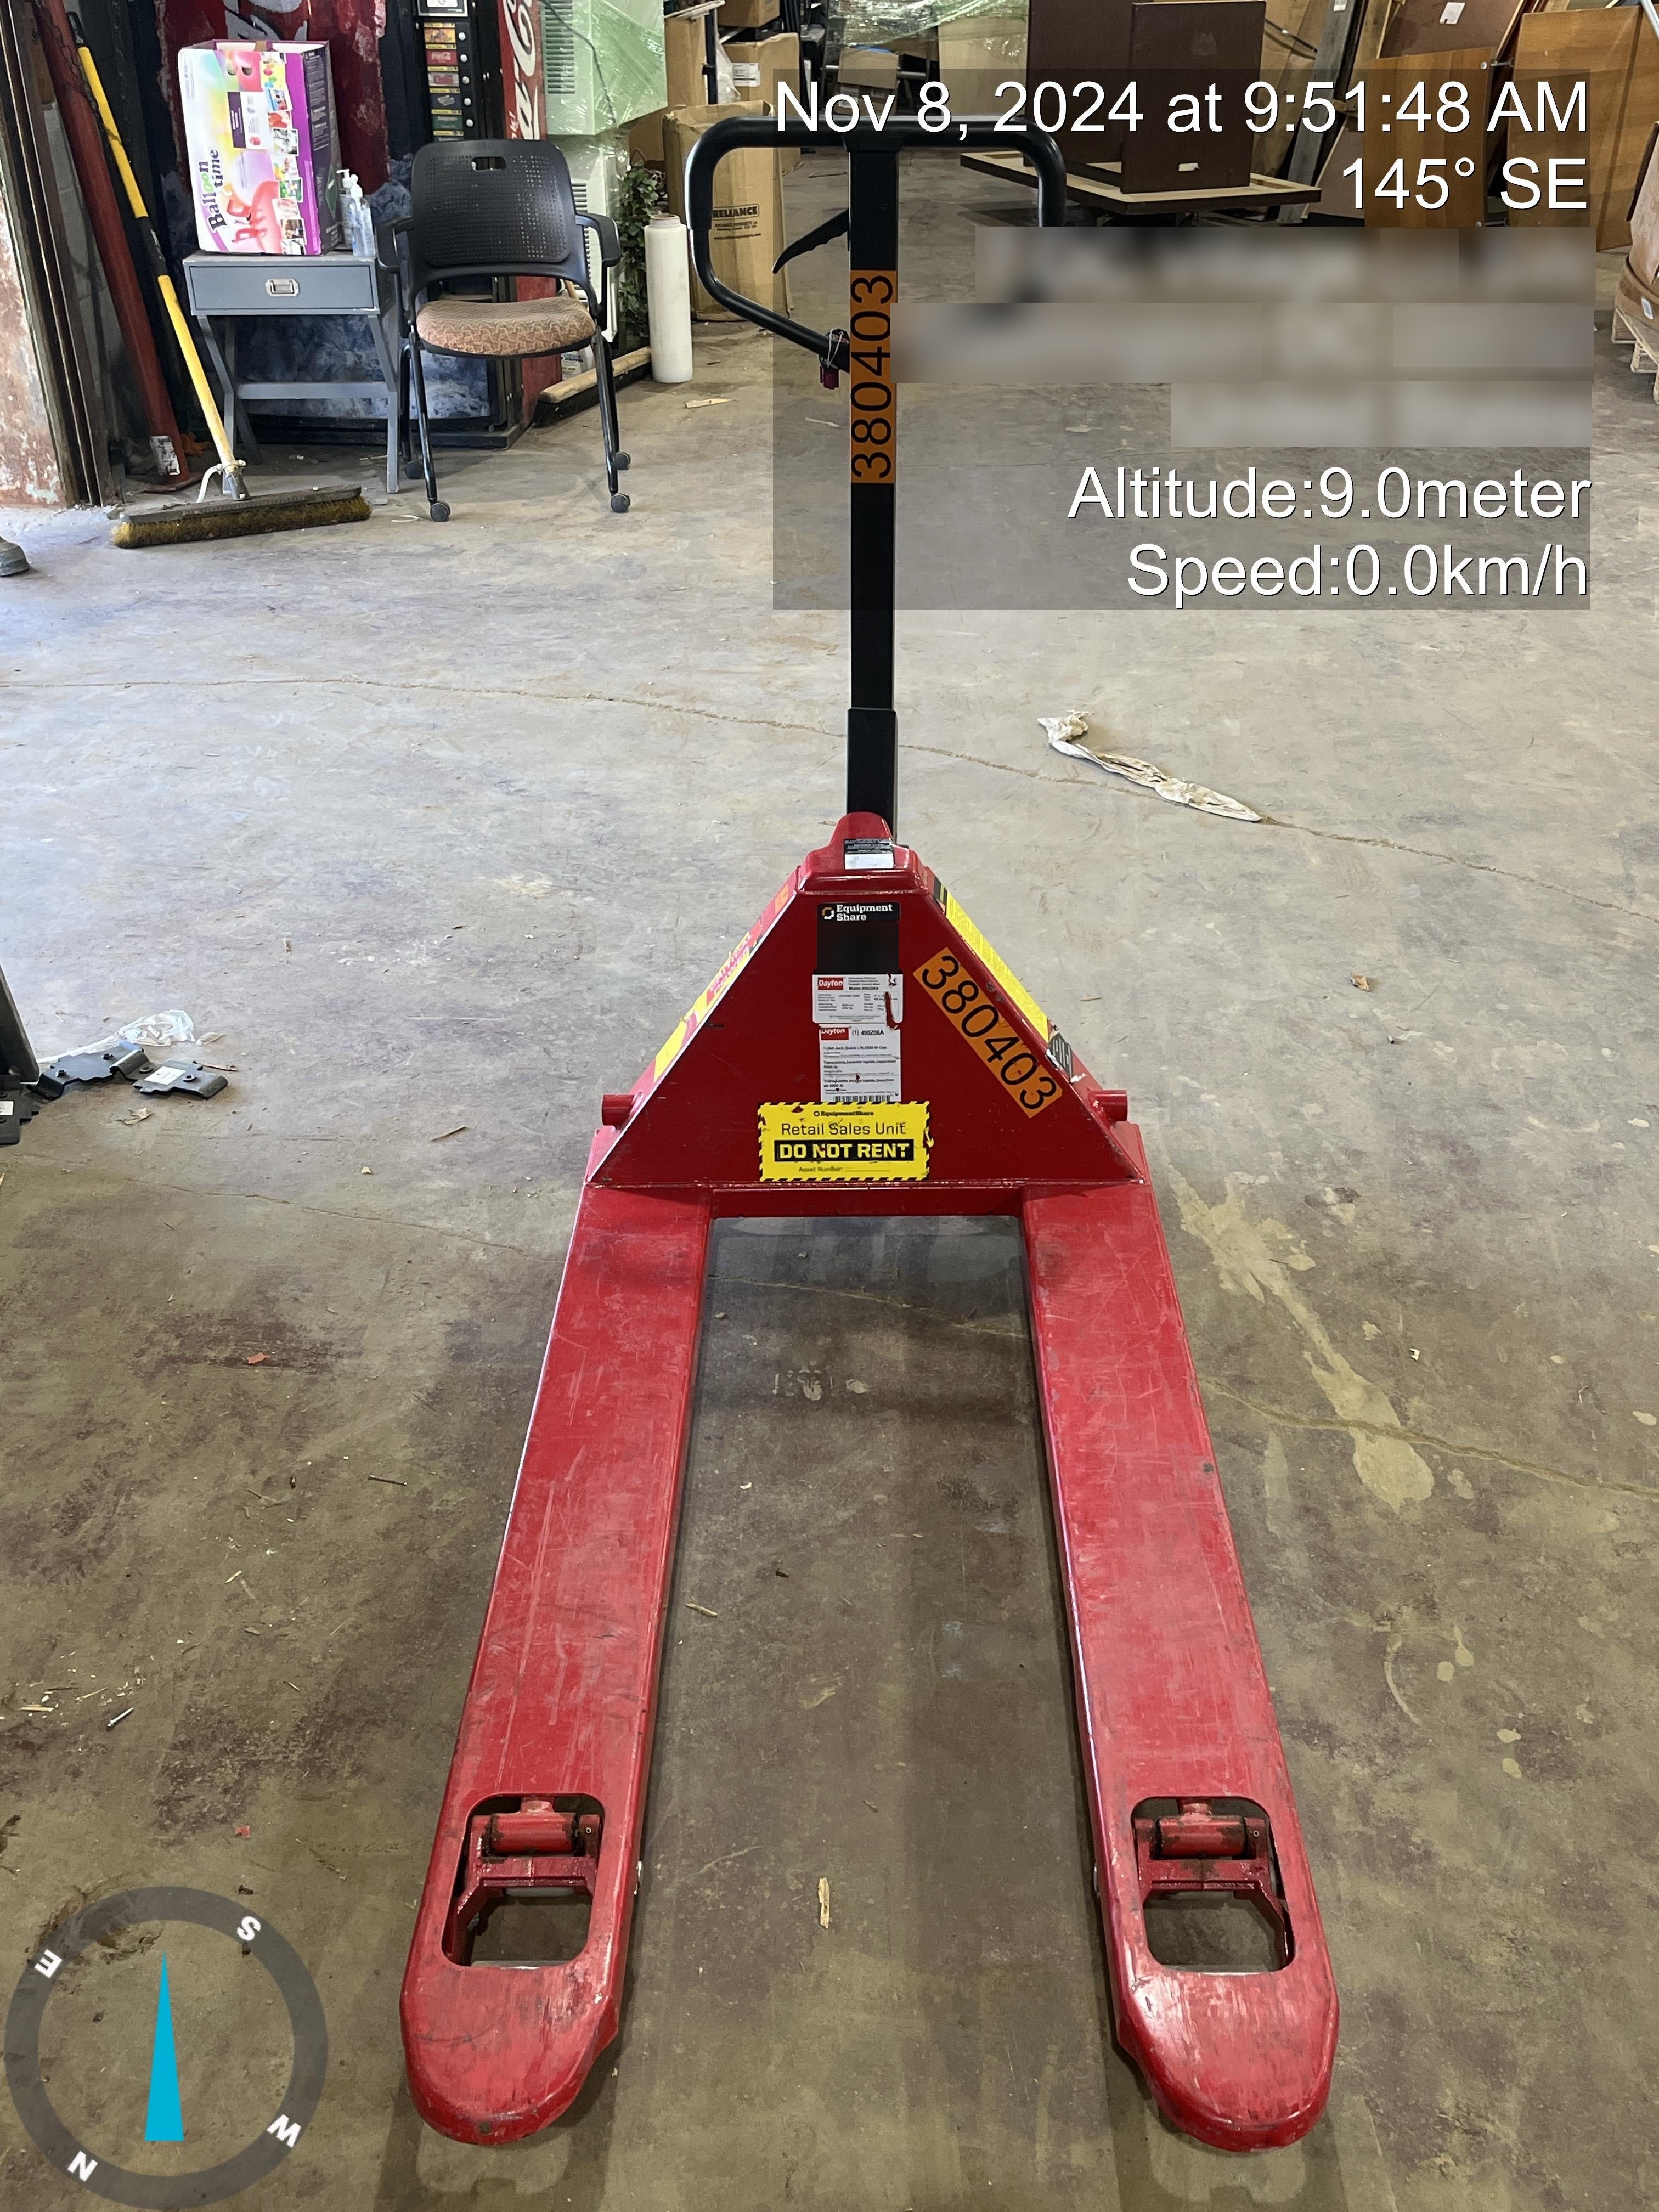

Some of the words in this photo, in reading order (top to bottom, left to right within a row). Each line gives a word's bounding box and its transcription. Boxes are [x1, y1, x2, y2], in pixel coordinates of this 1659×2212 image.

[210, 149, 223, 188] time
[199, 161, 227, 231] Balloon
[713, 206, 758, 218] RELIANCE
[850, 275, 893, 479] 380403
[836, 904, 893, 913] Equipment
[836, 913, 867, 922] Share
[818, 979, 843, 988] Dayton
[922, 955, 1057, 1110] 380403
[781, 1122, 824, 1135] Retail
[829, 1122, 870, 1135] Sales
[876, 1122, 906, 1135] Unit
[780, 1144, 806, 1159] DO
[812, 1143, 853, 1158] NOT
[857, 1143, 909, 1158] RENT
